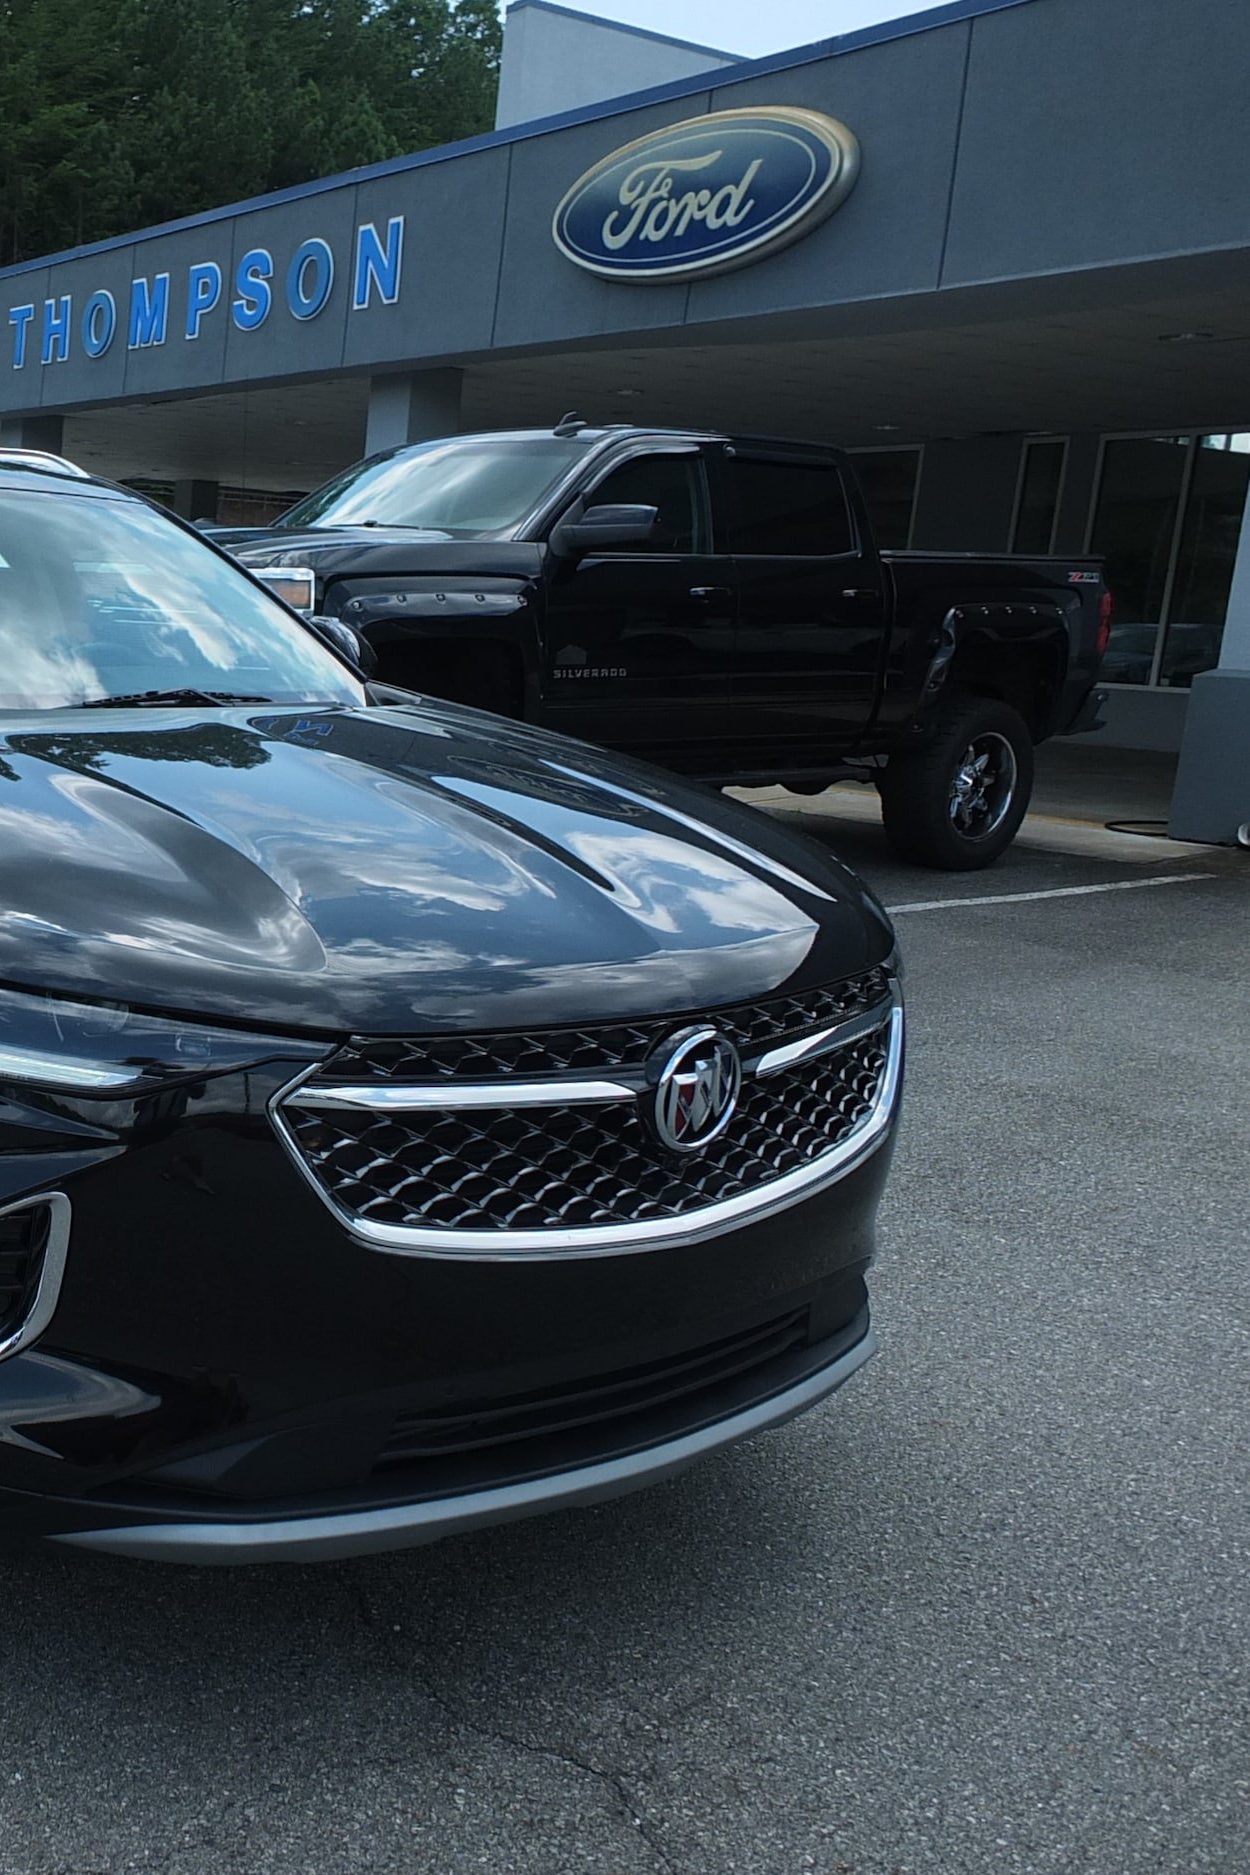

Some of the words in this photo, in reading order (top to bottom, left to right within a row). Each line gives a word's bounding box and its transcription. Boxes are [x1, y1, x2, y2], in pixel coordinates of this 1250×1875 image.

[602, 150, 764, 249] Ford
[8, 215, 406, 370] THOMPSON
[552, 667, 628, 679] SILVERADO
